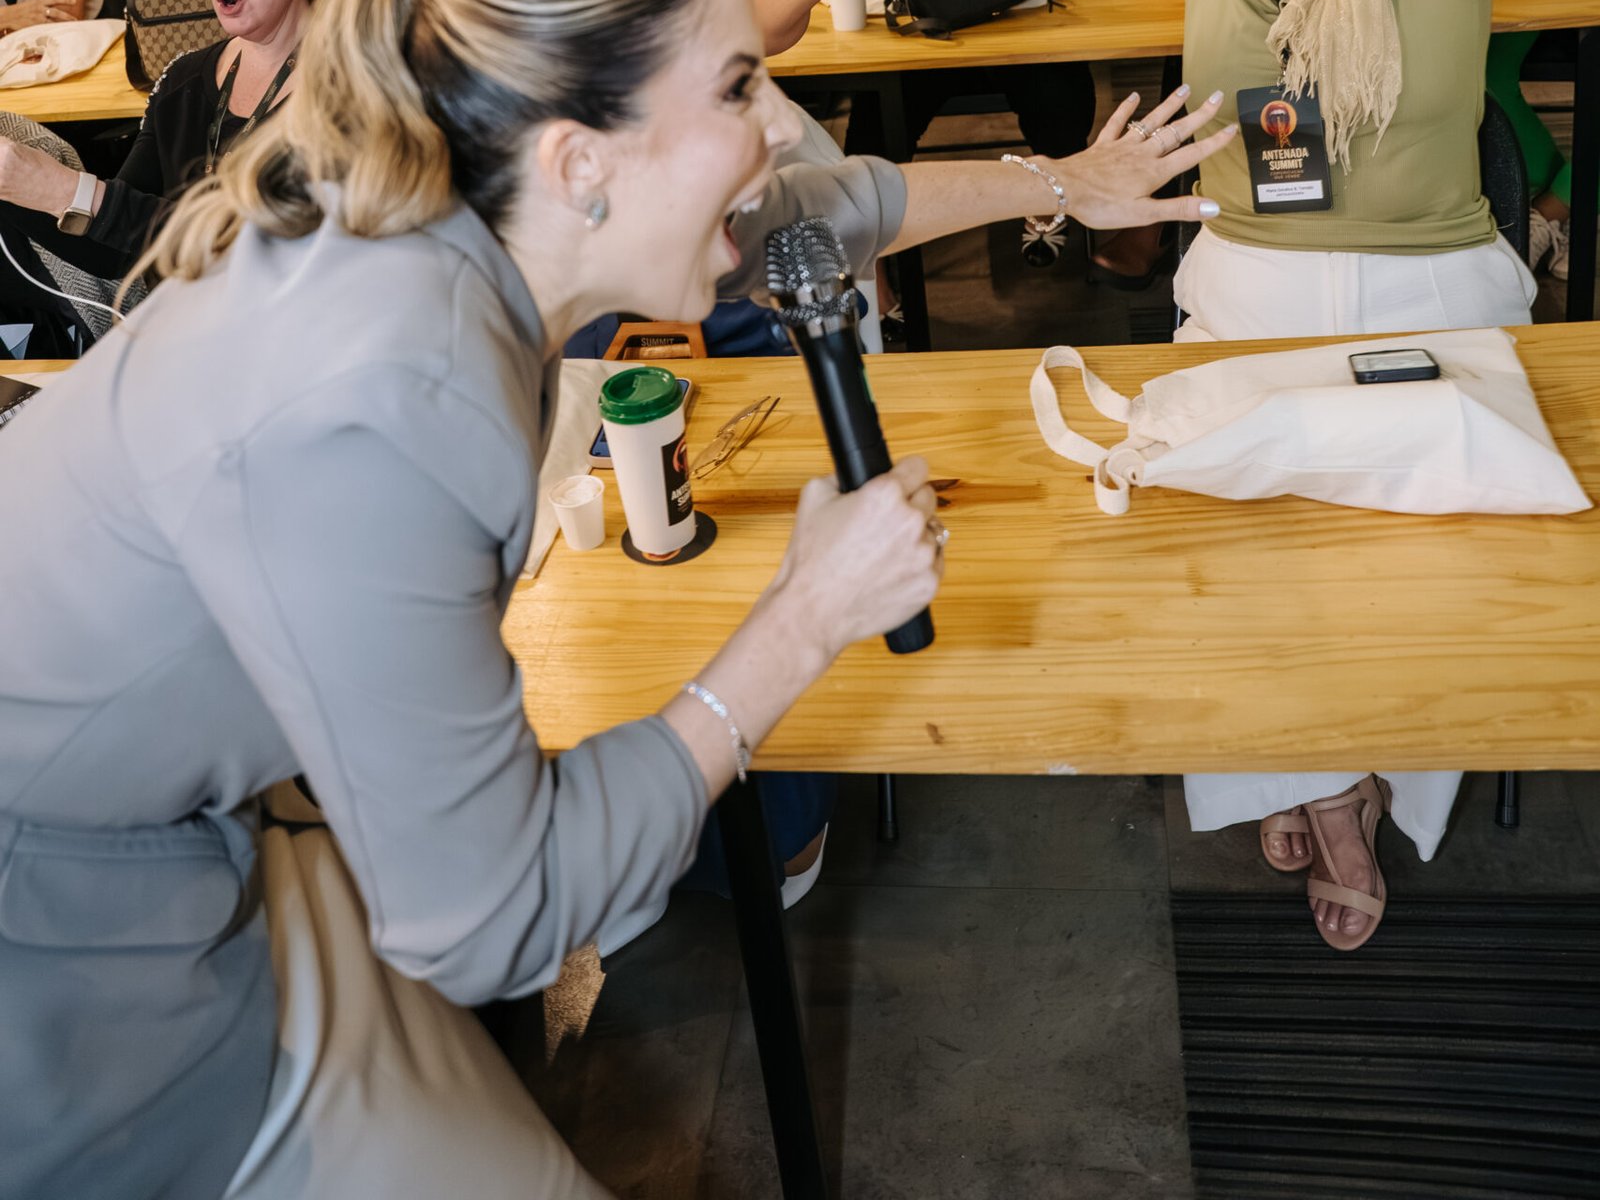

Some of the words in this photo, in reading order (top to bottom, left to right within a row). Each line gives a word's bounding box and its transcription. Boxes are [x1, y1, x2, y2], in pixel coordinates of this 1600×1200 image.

[1262, 148, 1309, 161] ANTENADA
[1269, 159, 1303, 171] SUMMIT
[641, 337, 675, 347] SUMMIT
